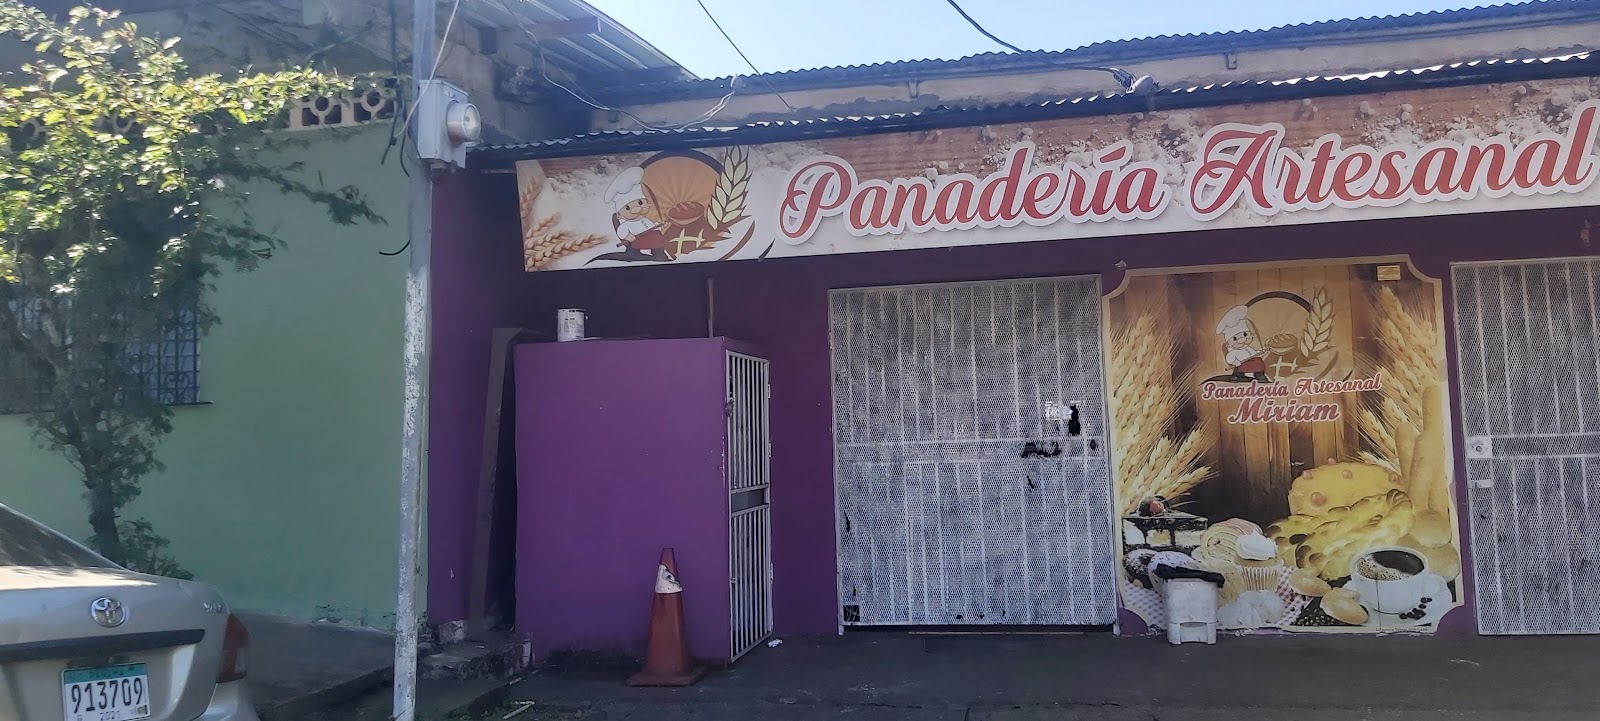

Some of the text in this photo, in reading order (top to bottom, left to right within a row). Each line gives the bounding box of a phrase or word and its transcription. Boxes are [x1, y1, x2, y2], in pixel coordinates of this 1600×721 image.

[778, 106, 1595, 239] Panadería Artesanal
[1202, 373, 1382, 399] Panadería Artesanal
[1228, 398, 1340, 423] Miriam
[71, 677, 143, 714] 913709
